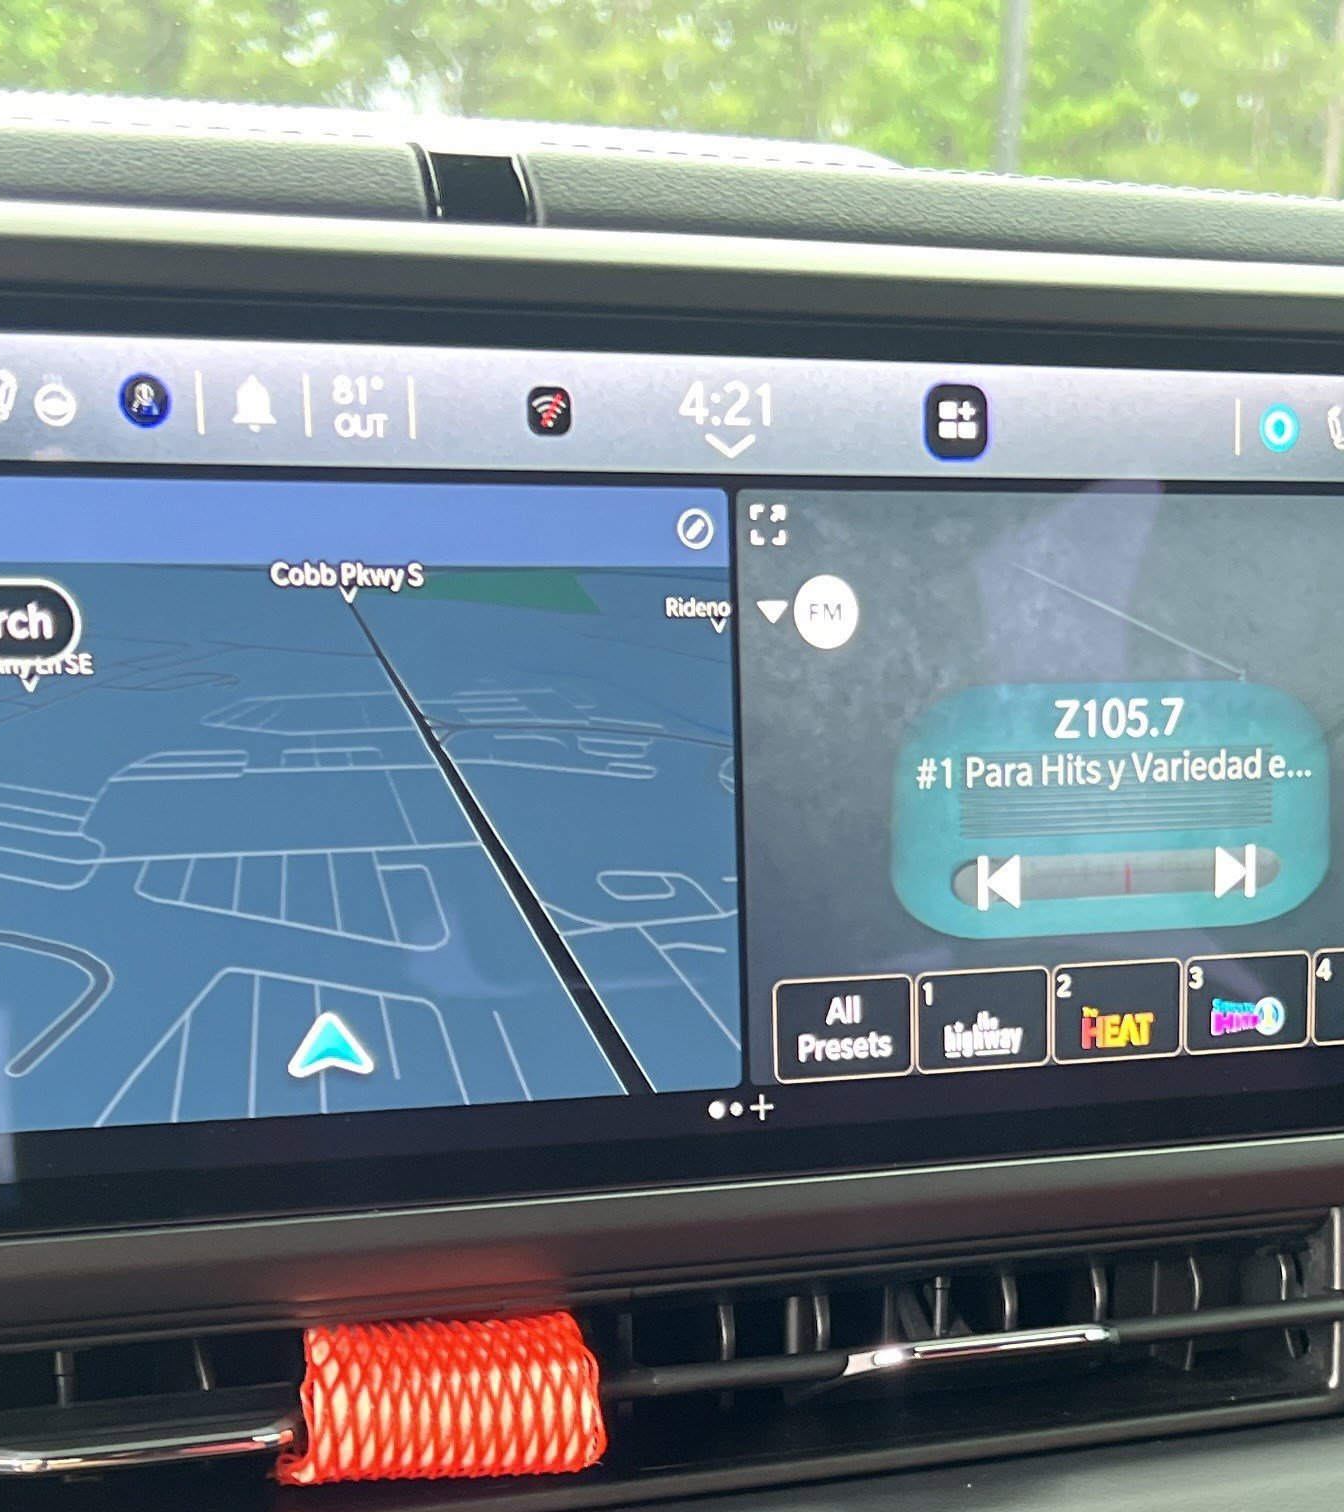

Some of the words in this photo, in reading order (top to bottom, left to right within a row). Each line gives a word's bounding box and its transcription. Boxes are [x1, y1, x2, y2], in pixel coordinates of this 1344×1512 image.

[678, 380, 773, 427] 4:21
[335, 412, 389, 438] OUT
[270, 562, 337, 587] Cobb
[341, 562, 405, 592] Pkwy
[407, 562, 424, 587] S
[664, 597, 730, 619] Rideno
[809, 602, 843, 621] FM
[64, 653, 94, 675] SE
[1054, 697, 1184, 739] Z105.7
[916, 762, 954, 790] #1
[966, 759, 1035, 789] Para
[1041, 753, 1101, 785] Hits
[1109, 758, 1126, 790] y
[1131, 747, 1262, 783] Variedad
[1189, 967, 1204, 990] 3
[1316, 957, 1333, 982] 4
[922, 982, 935, 1006] 1
[1056, 975, 1072, 998] 2
[826, 996, 862, 1026] All
[944, 1022, 1023, 1058] highway
[1081, 1012, 1155, 1050] HEAT
[797, 1031, 893, 1063] Presets
